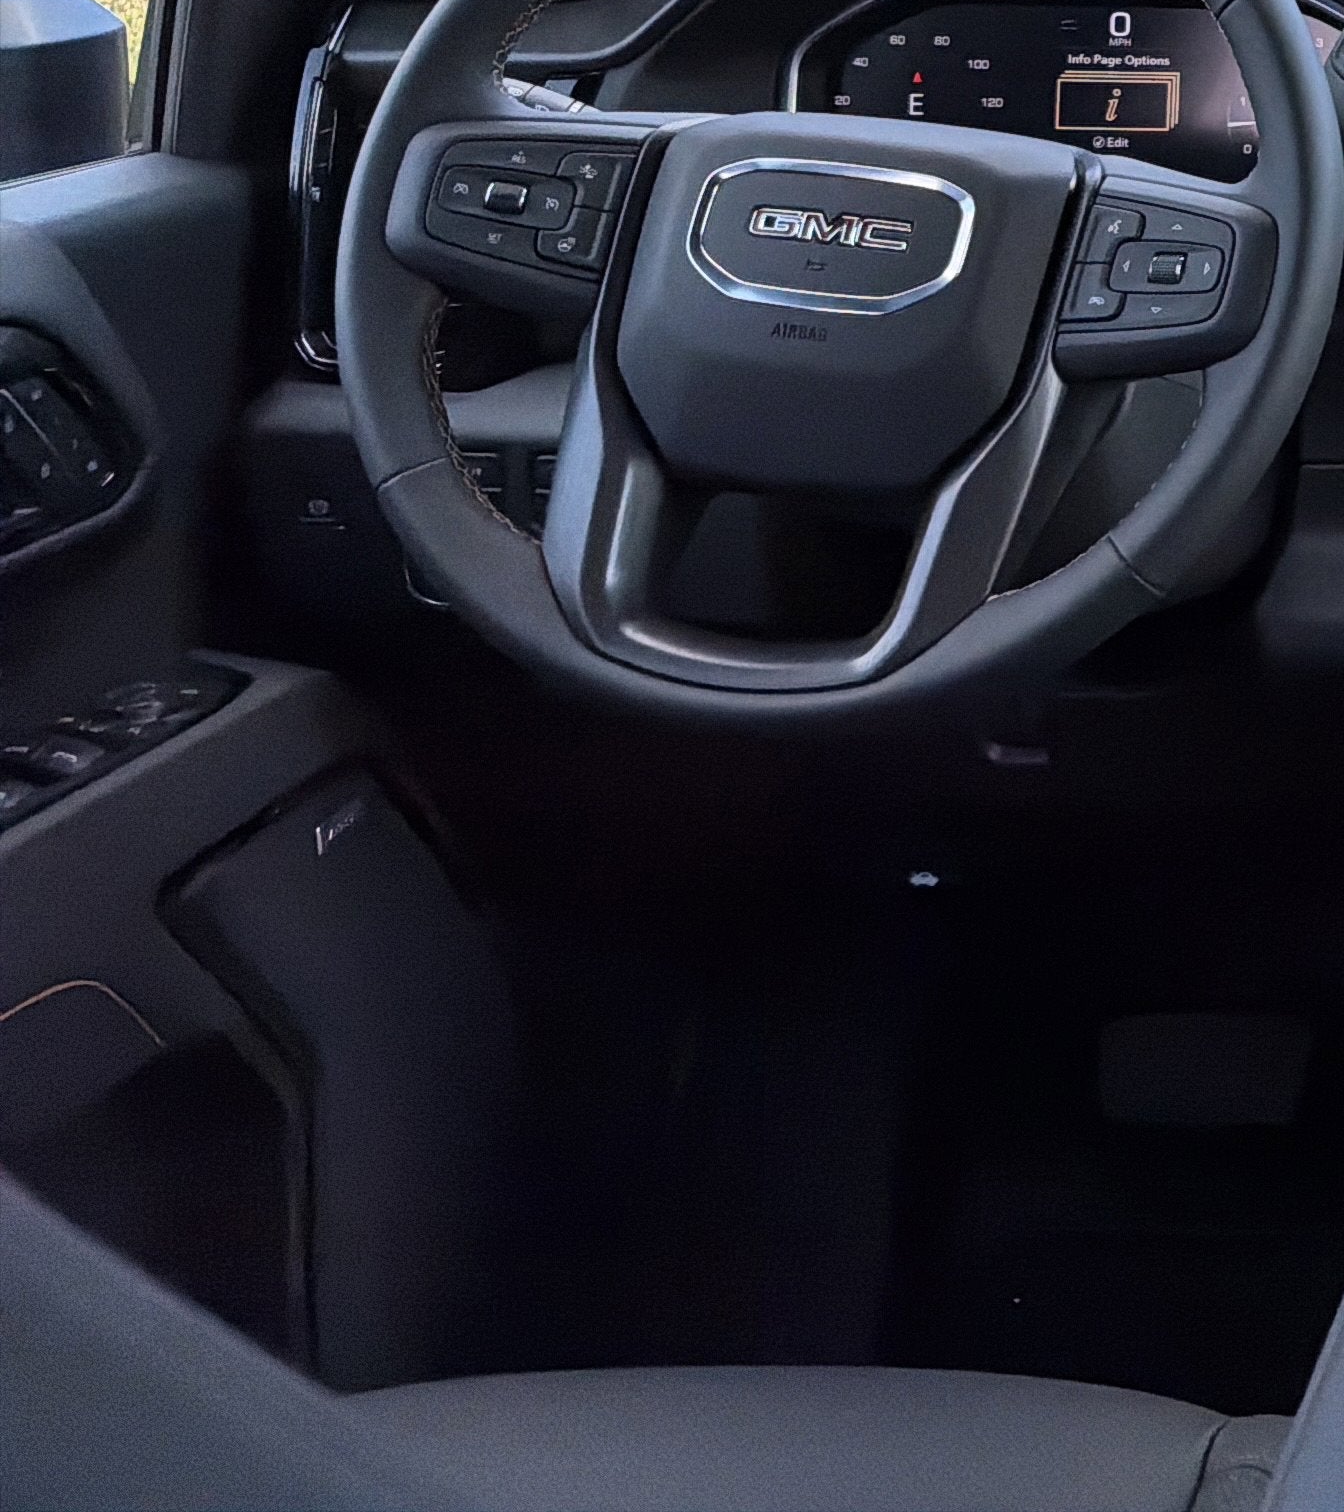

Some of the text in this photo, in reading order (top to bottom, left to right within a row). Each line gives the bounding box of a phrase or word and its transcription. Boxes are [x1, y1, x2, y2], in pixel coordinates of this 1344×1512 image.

[1109, 11, 1131, 37] 0
[889, 35, 906, 45] 60
[934, 36, 950, 46] 80
[1109, 38, 1132, 47] MPH
[852, 57, 869, 68] 40
[967, 59, 990, 70] 100
[1067, 53, 1170, 67] Info Page Options
[834, 95, 850, 106] 20
[981, 97, 1004, 108] 120
[1107, 137, 1129, 148] Edit
[749, 206, 914, 251] GMC
[771, 322, 829, 341] AIRBAG
